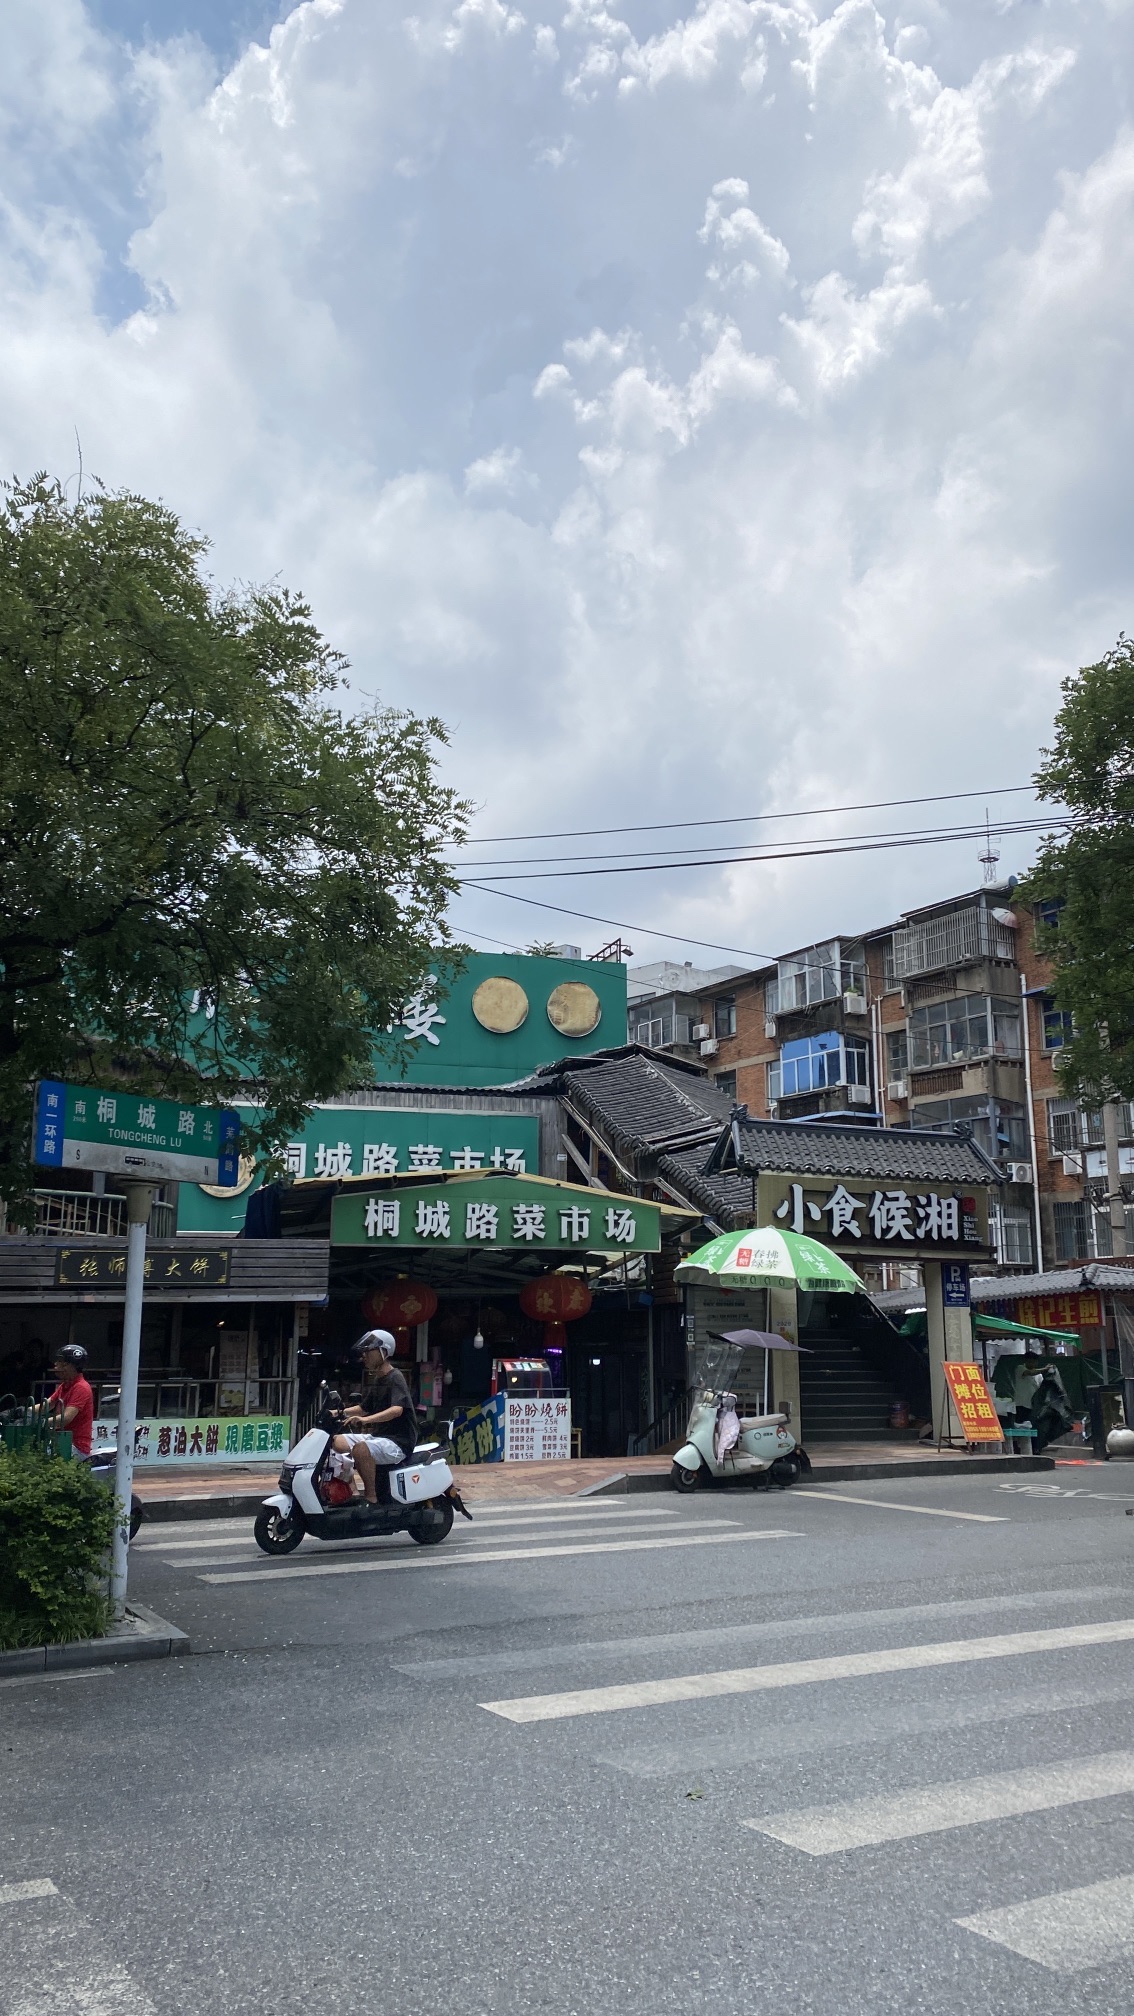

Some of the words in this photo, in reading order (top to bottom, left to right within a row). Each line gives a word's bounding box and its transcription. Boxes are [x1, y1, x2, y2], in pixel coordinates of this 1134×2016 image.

[75, 1100, 87, 1115] 南
[43, 1093, 59, 1155] 南一环路
[97, 1096, 195, 1136] 桐城路
[203, 1121, 213, 1135] 北
[108, 1128, 166, 1145] TONGCHENG
[170, 1137, 182, 1148] LU
[76, 1149, 81, 1160] S
[204, 1166, 209, 1176] N
[776, 1183, 959, 1241] 小食候湘
[364, 1198, 637, 1244] 桐城路菜市场
[951, 1265, 962, 1282] P
[1018, 1294, 1100, 1327] 徐记生煎
[949, 1365, 981, 1381] 门面
[954, 1384, 987, 1400] 摊位
[960, 1402, 993, 1418] 招租
